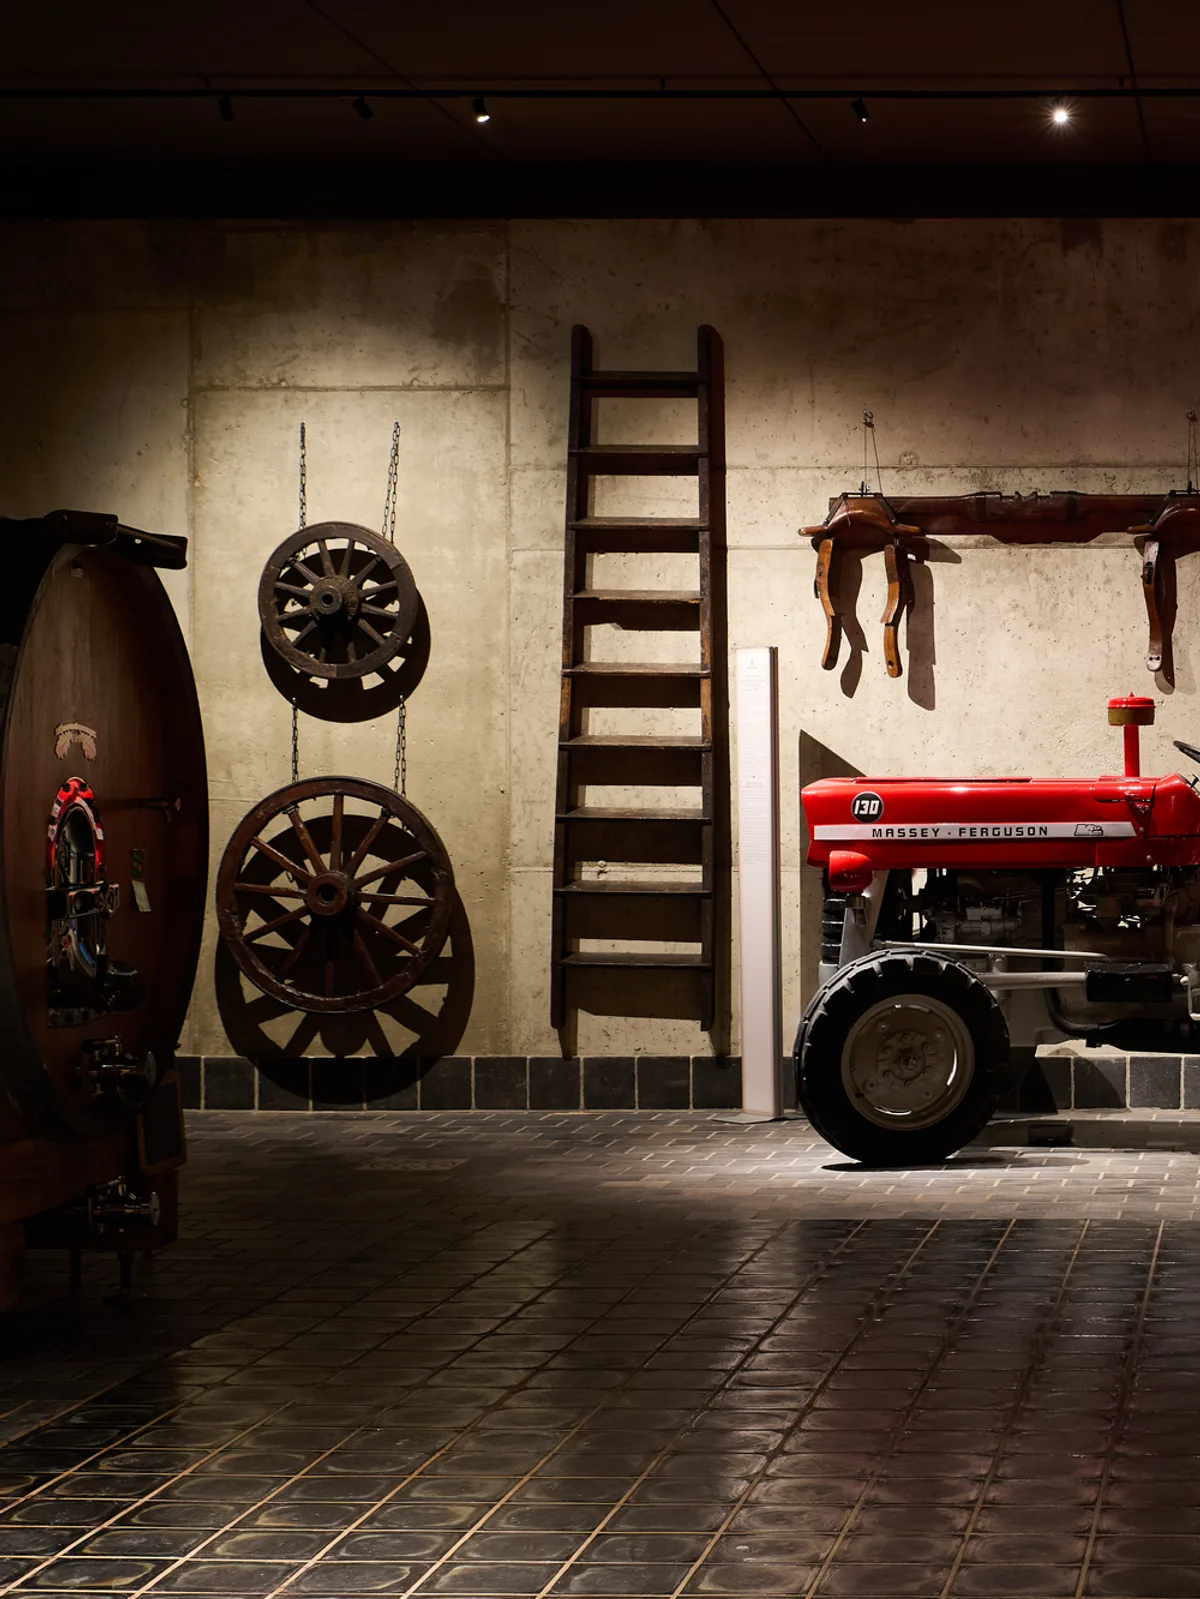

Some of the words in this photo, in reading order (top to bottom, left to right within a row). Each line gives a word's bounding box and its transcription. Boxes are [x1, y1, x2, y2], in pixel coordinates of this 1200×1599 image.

[854, 800, 880, 815] 130
[872, 828, 940, 838] MASSEY
[958, 826, 1049, 838] FERGUSON
